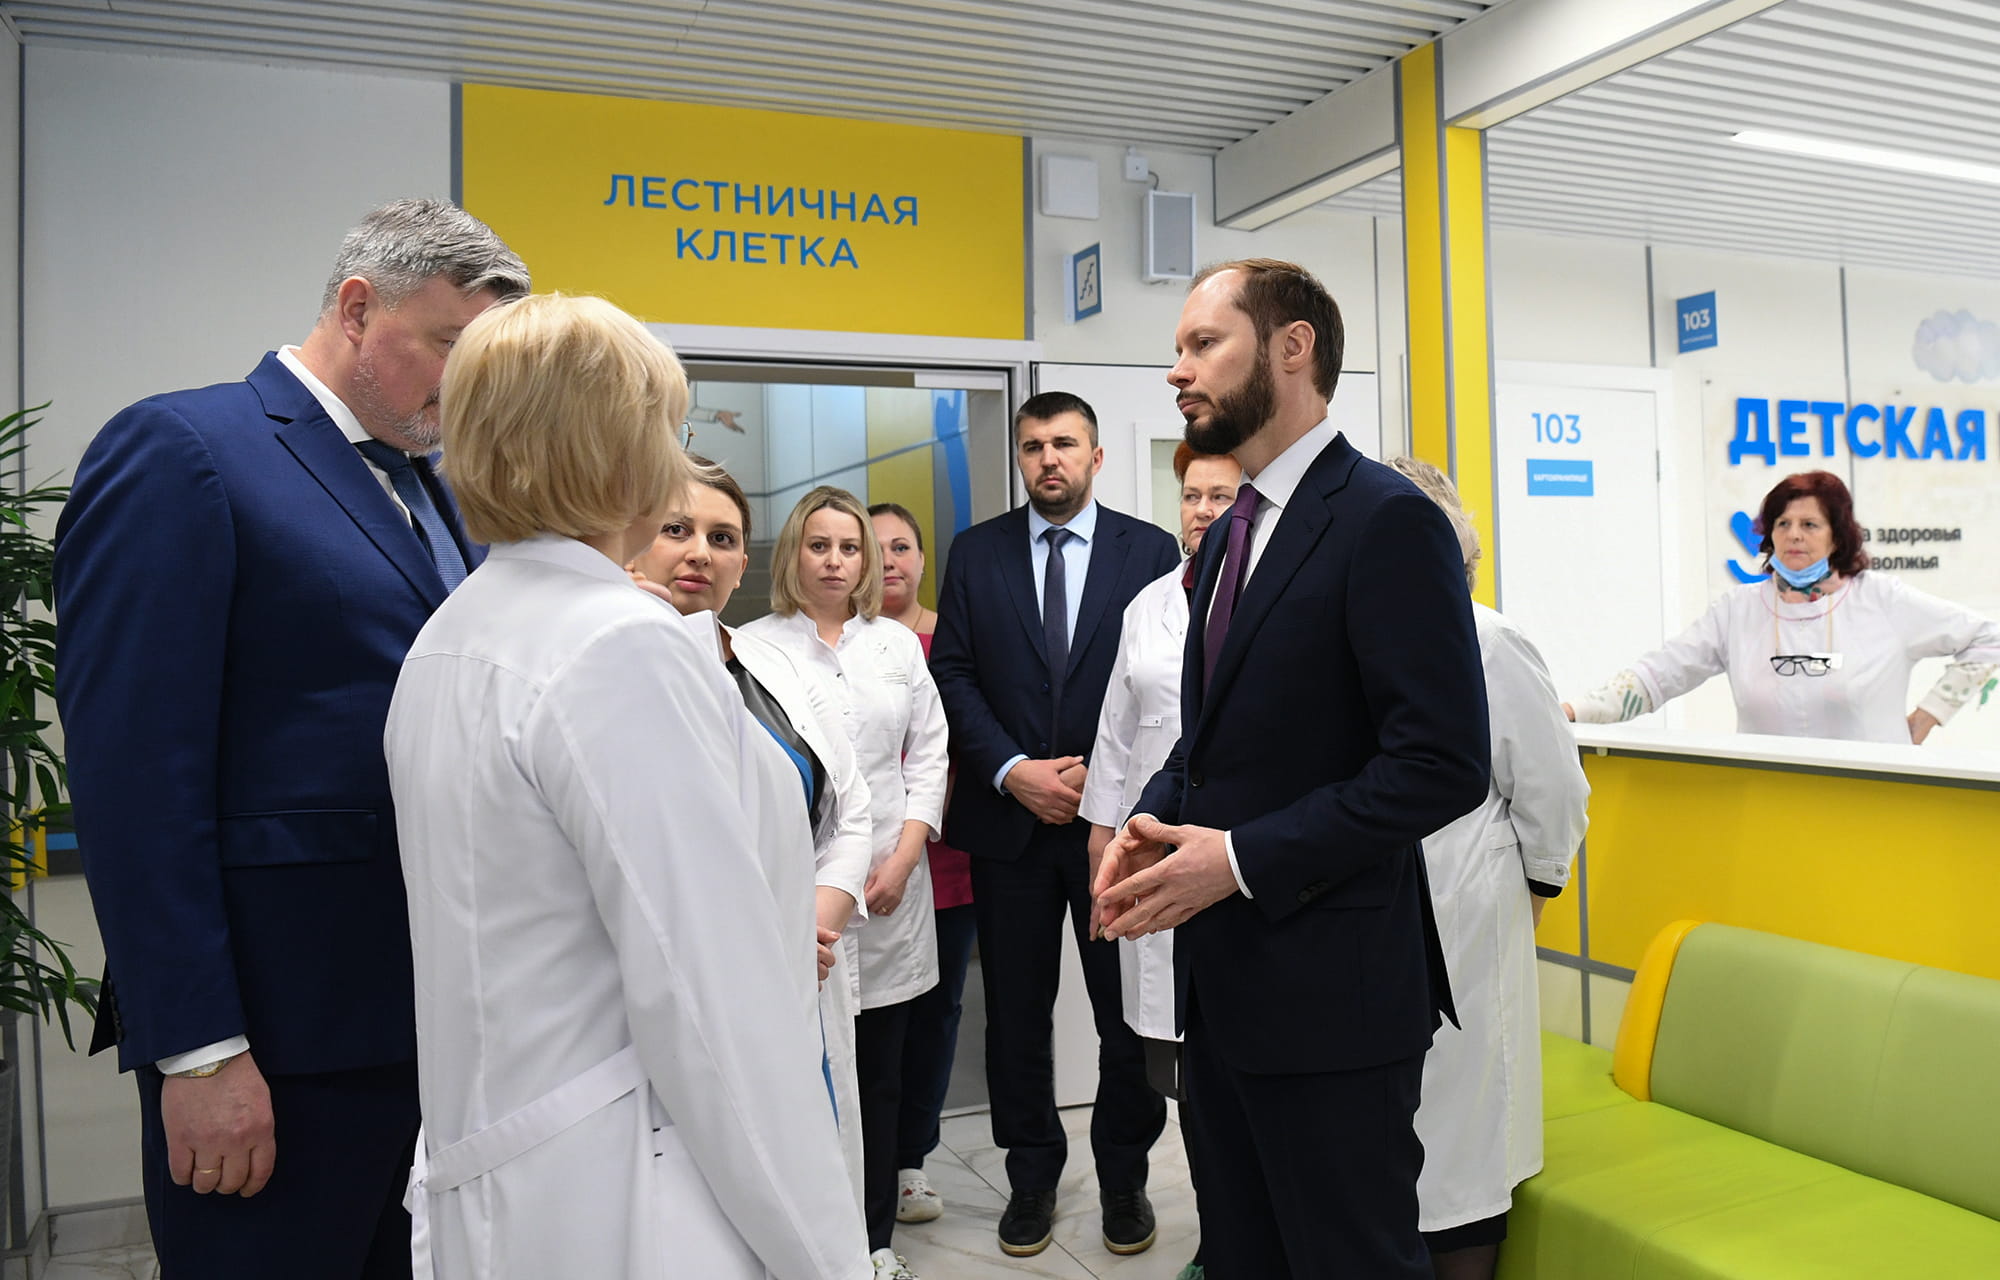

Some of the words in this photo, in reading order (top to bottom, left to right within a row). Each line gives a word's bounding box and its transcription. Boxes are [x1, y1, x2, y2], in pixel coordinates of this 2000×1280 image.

[603, 173, 918, 226] ЛЕСТНИЧНАЯ
[676, 227, 859, 269] КЛЕТКА
[1682, 308, 1711, 331] 103
[1531, 412, 1581, 444] 103
[1728, 397, 1986, 466] ДЕТСКАЯ
[1877, 528, 1962, 545] здоровья
[1870, 556, 1939, 570] волжья
